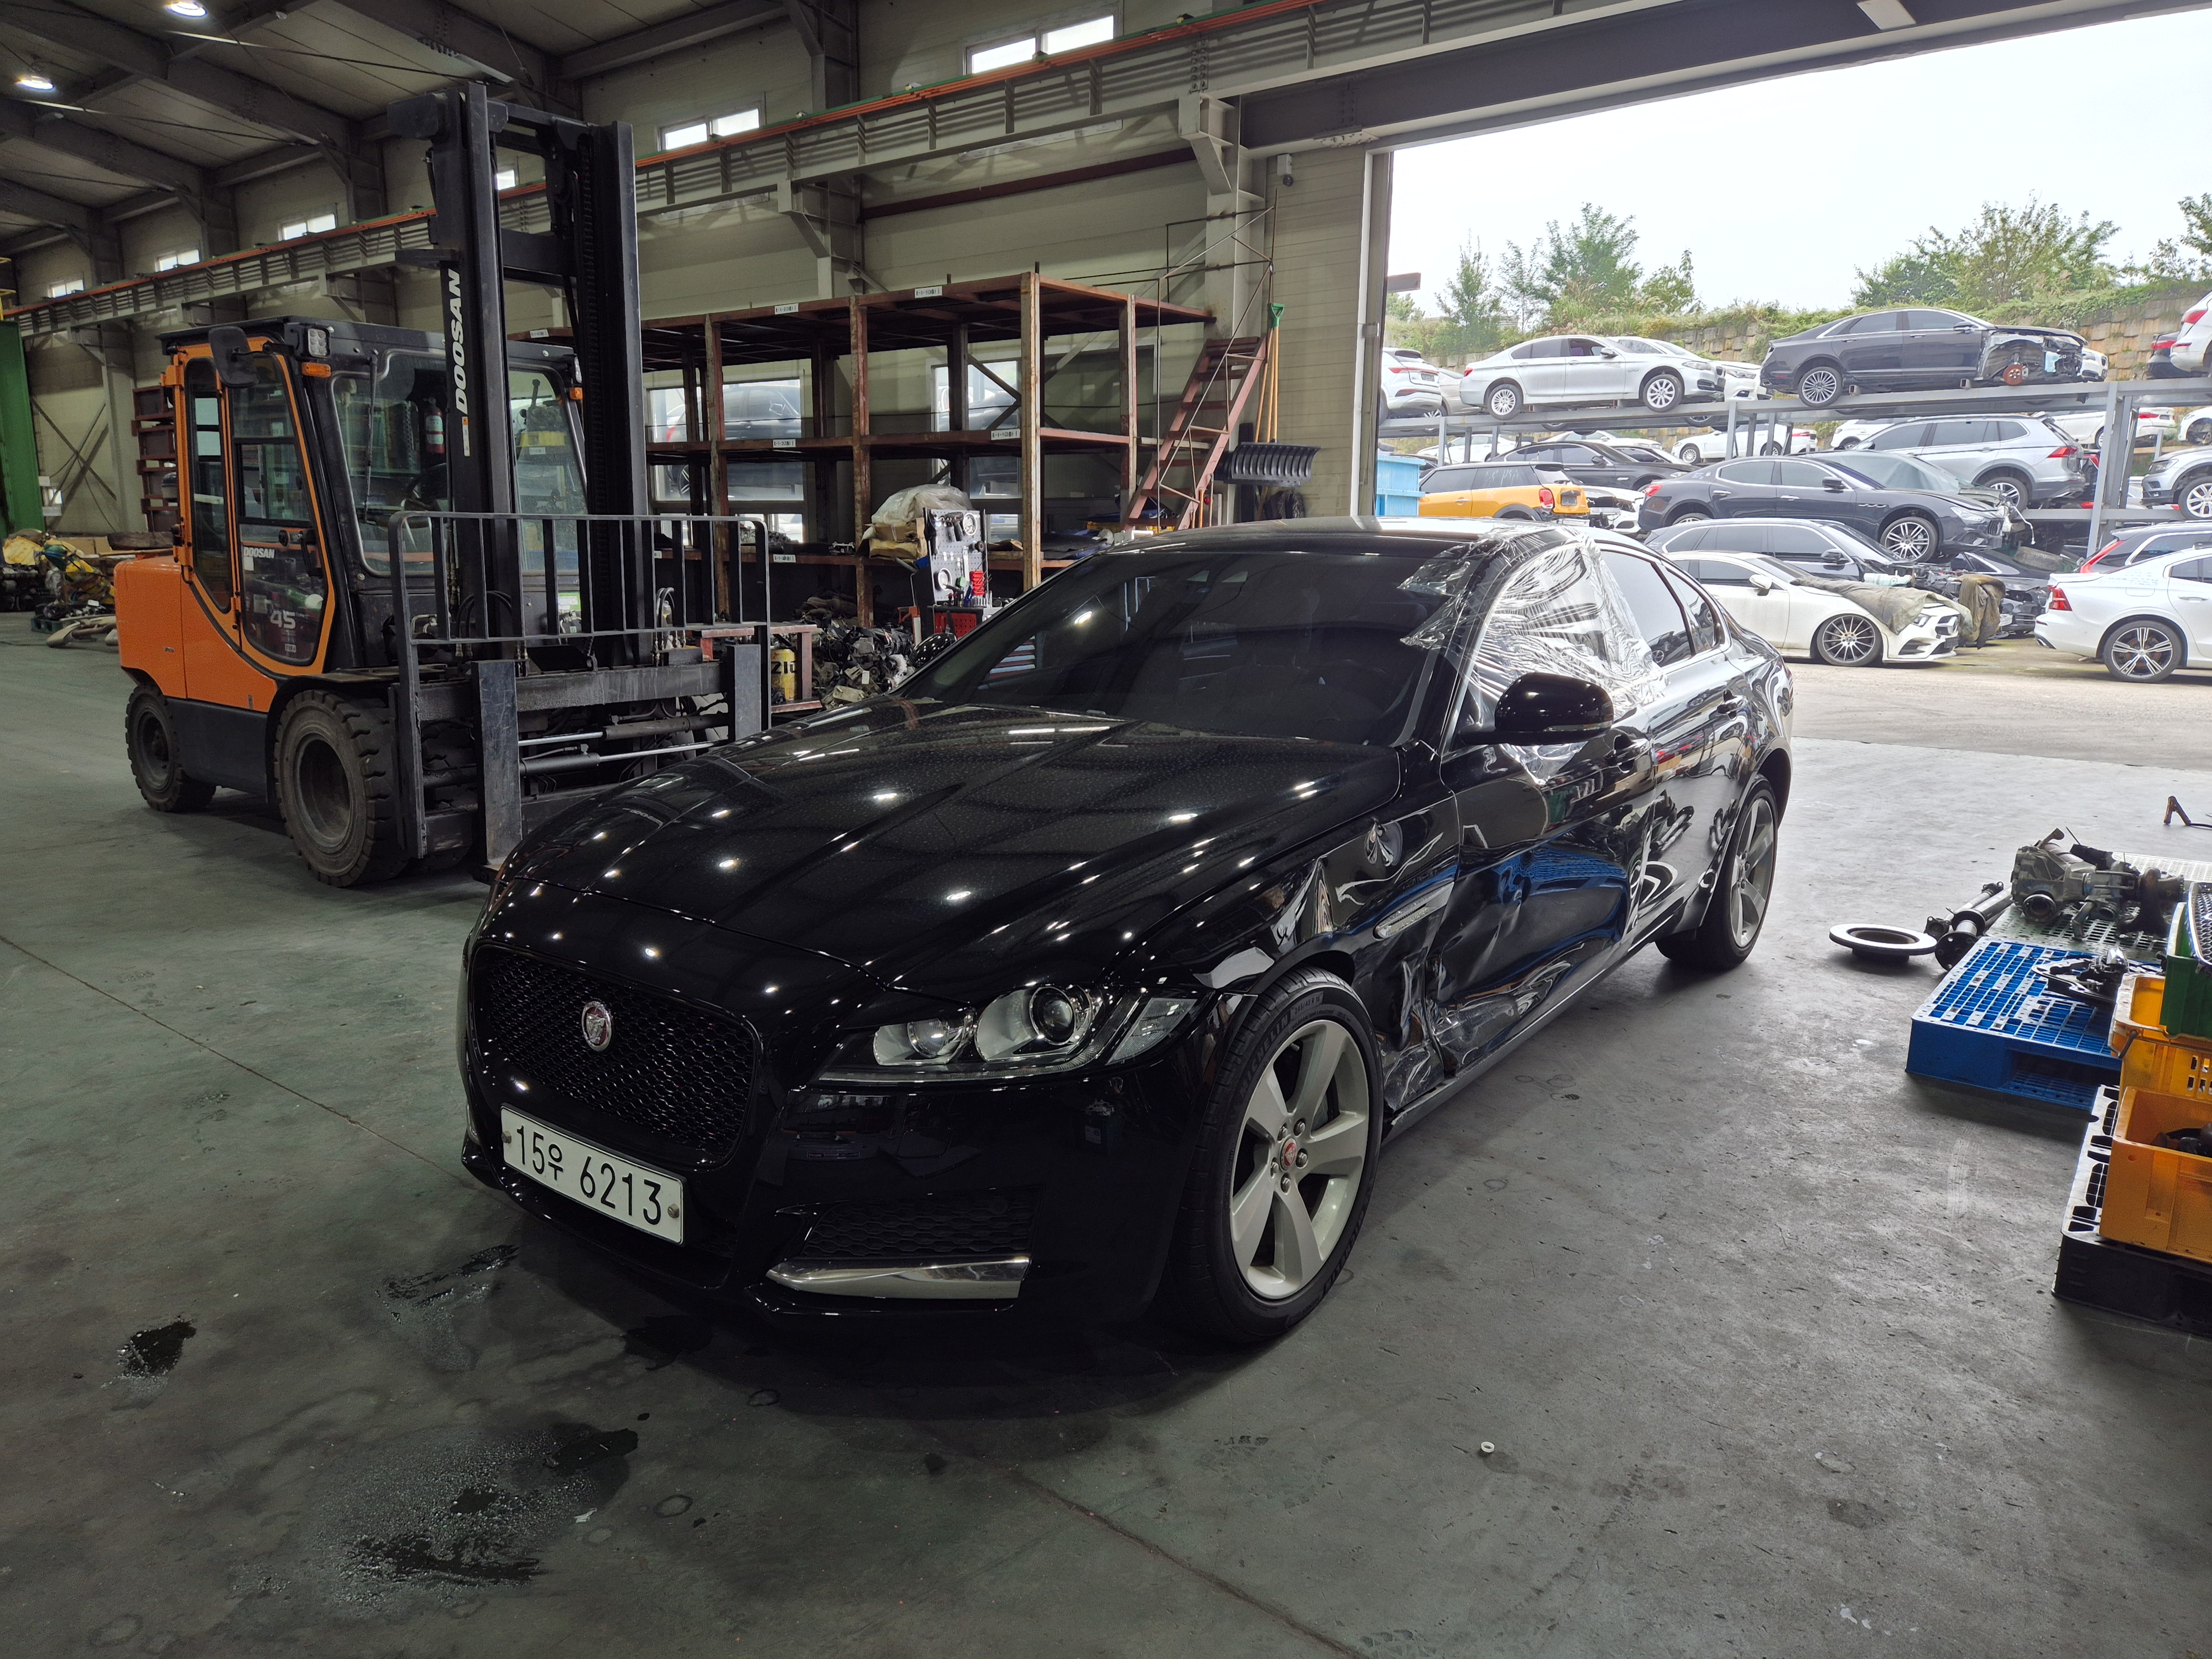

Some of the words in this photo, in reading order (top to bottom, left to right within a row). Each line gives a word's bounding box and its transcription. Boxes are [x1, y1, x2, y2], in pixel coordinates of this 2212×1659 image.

[448, 268, 468, 415] DOOSAN
[243, 546, 275, 559] DOOSAN
[270, 609, 296, 629] 45
[1239, 1013, 1290, 1099] MICHELIN
[517, 1124, 564, 1181] 15우
[580, 1156, 661, 1225] 6213
